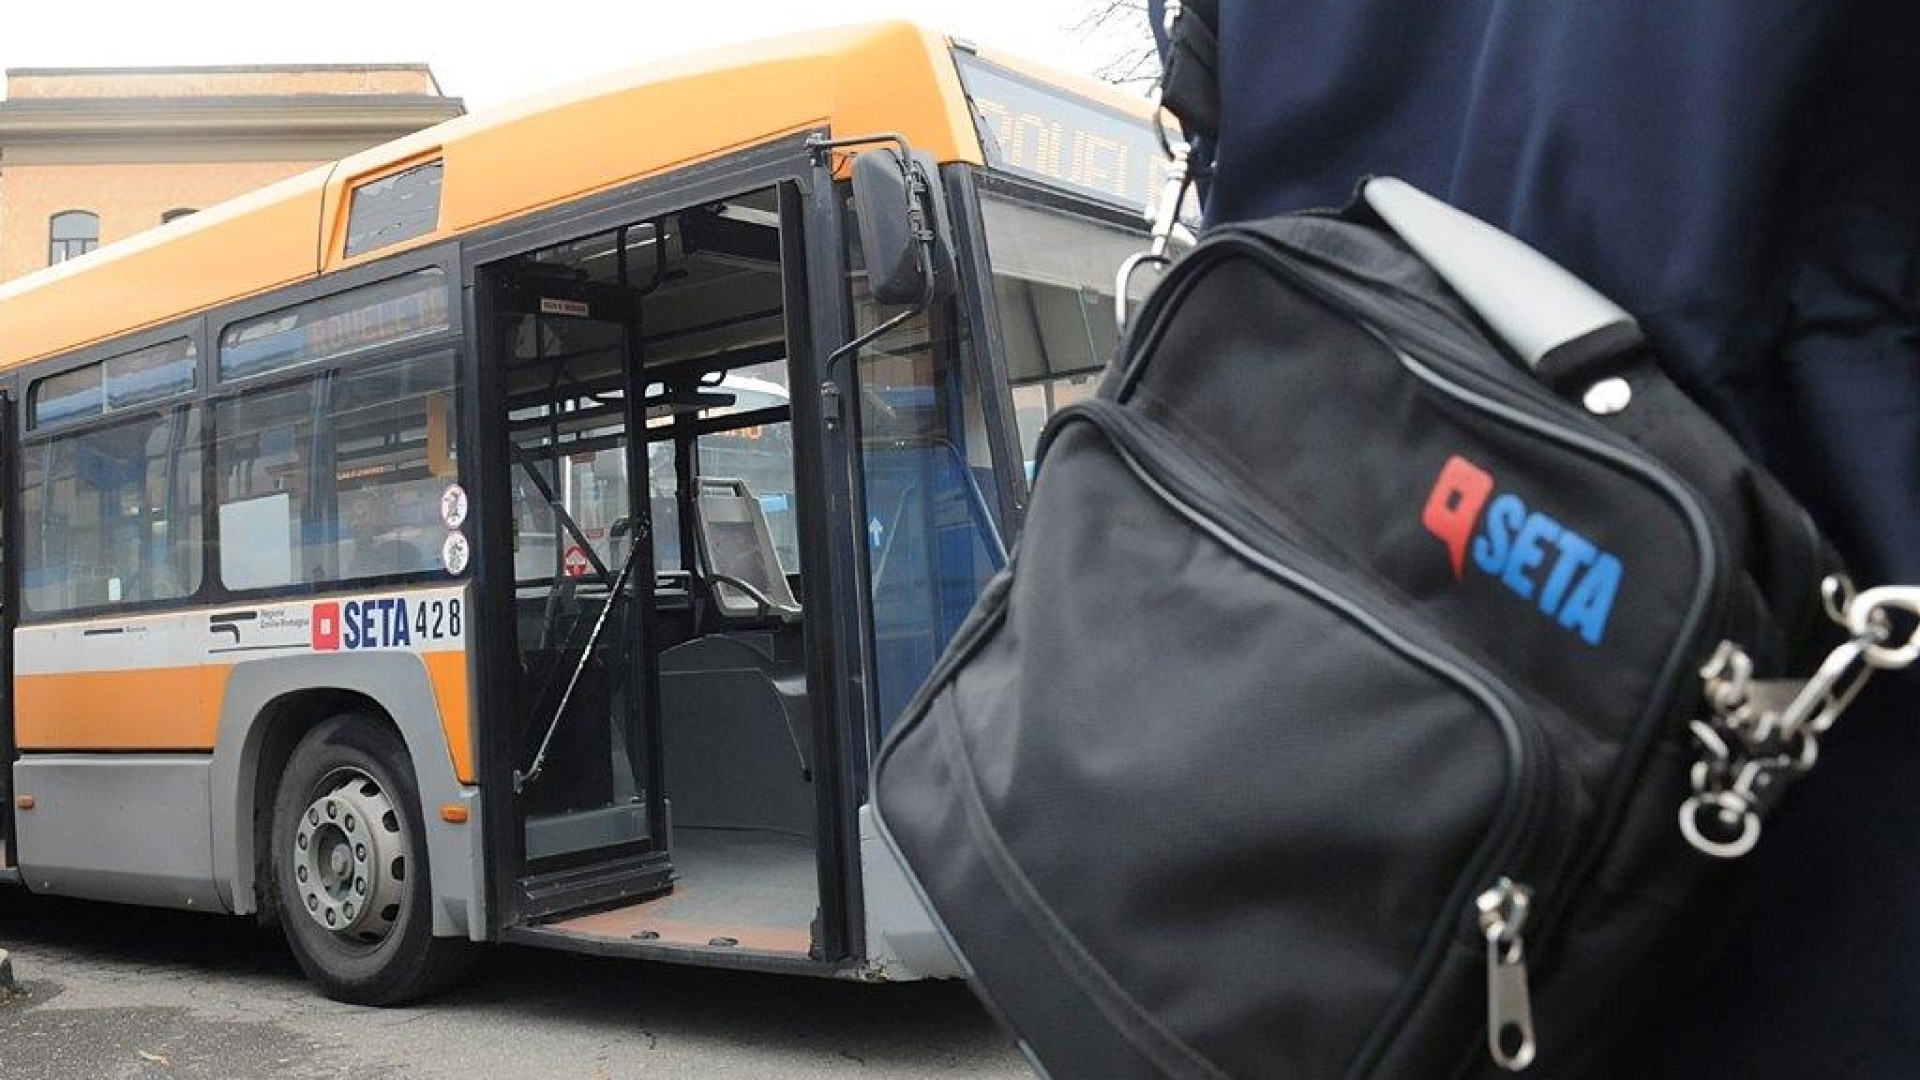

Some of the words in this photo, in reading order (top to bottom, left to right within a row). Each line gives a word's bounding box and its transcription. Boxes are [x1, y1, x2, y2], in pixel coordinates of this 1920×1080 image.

[1472, 493, 1624, 645] SETA
[344, 598, 411, 648] SETA
[415, 598, 460, 638] 428
